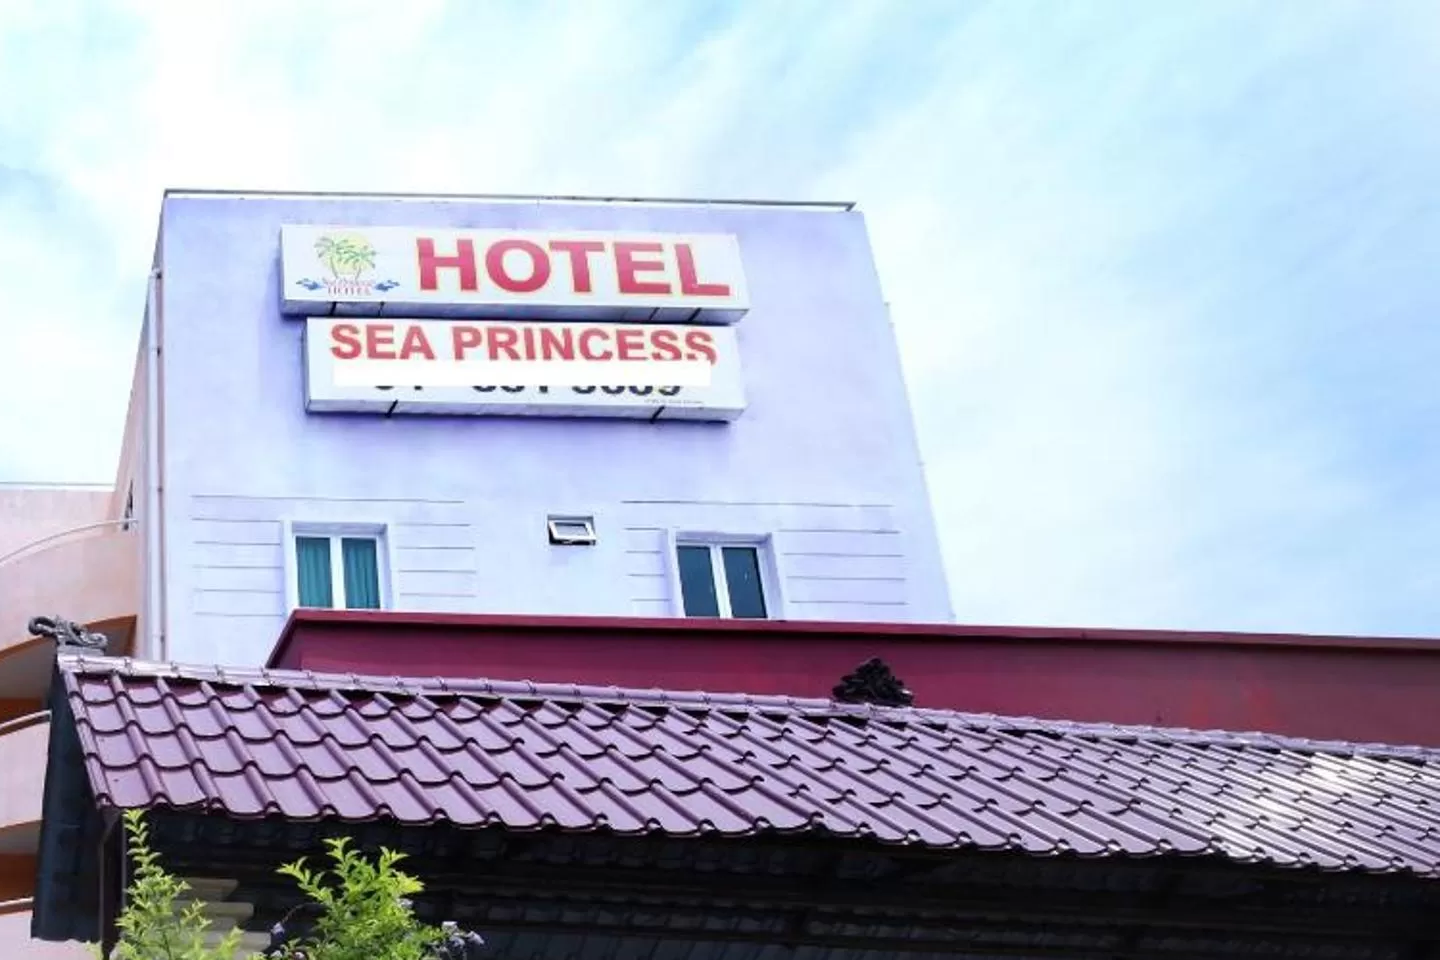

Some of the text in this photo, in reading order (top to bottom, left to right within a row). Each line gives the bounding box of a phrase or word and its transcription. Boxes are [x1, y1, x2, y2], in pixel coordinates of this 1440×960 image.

[416, 237, 731, 297] HOTEL
[330, 323, 718, 366] SEA PRINCESS
